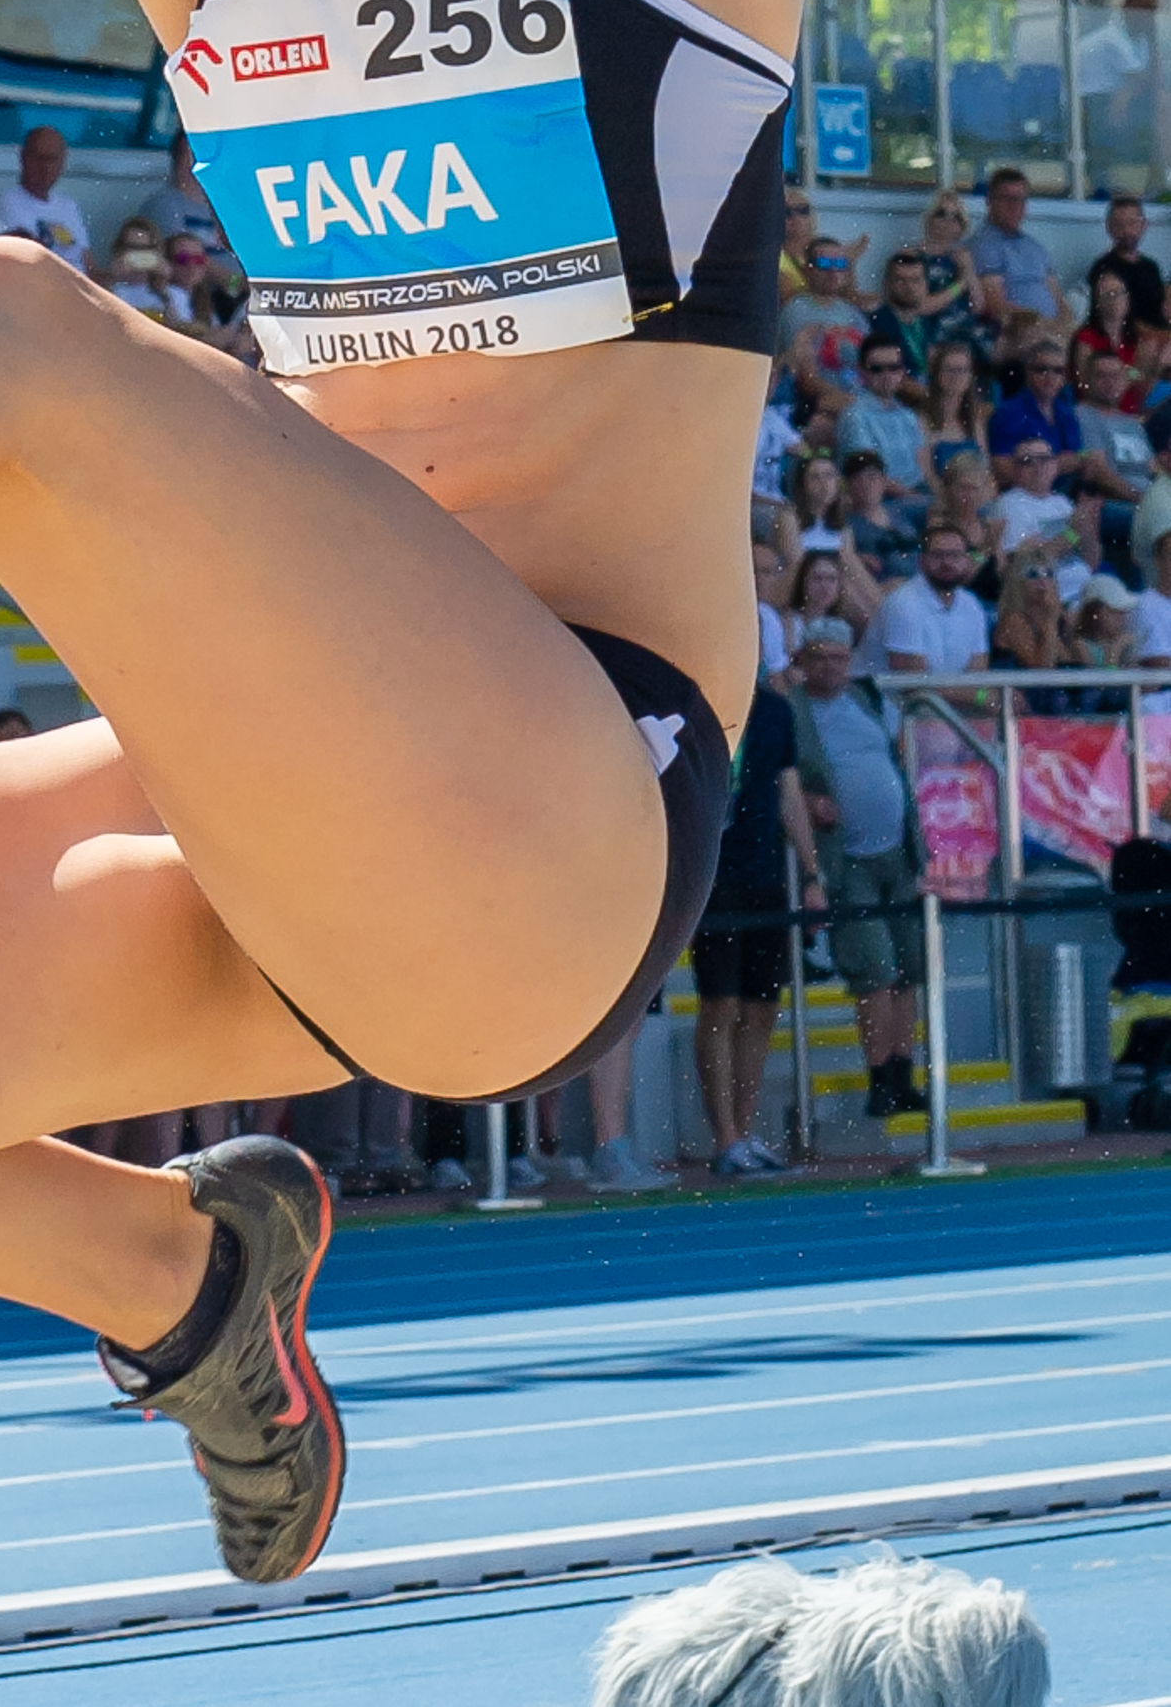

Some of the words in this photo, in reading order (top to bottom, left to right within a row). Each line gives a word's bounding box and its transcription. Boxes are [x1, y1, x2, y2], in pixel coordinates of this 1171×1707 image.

[236, 40, 322, 76] ORLEN
[255, 142, 498, 248] FAKA
[284, 290, 321, 310] PZLA
[323, 275, 498, 310] MISTRZOSTWA
[503, 254, 601, 289] POLSKI
[306, 329, 416, 364] LUBLIN
[427, 315, 519, 354] 2018
